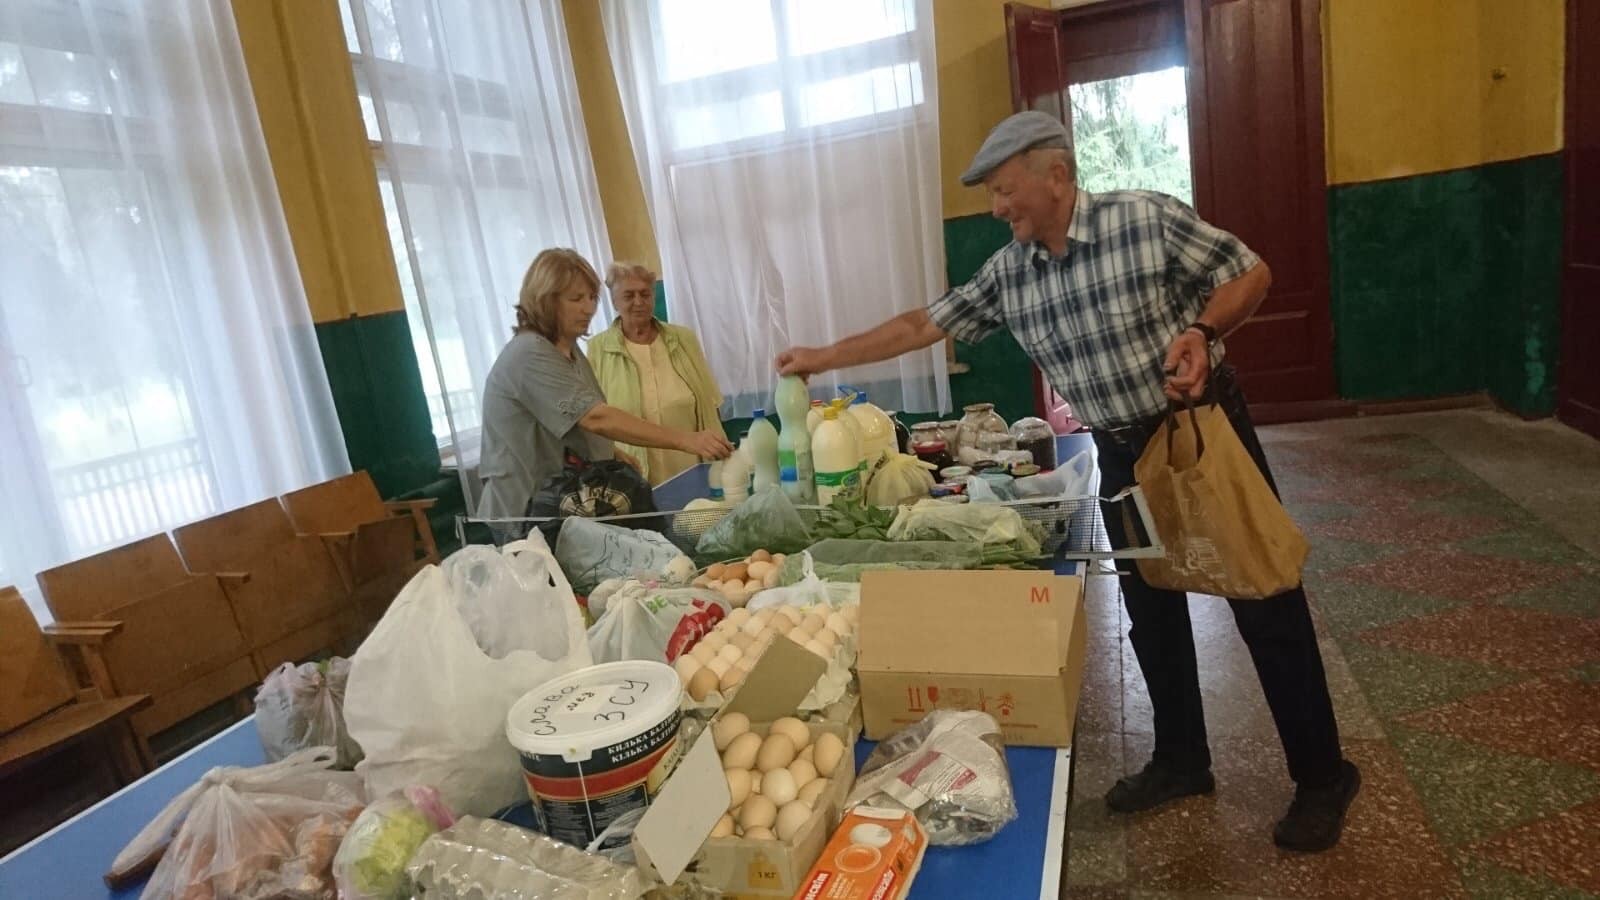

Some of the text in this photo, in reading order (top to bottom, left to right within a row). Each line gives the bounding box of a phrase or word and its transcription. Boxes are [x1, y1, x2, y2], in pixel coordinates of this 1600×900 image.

[1031, 586, 1050, 603] M
[608, 733, 649, 755] КИЛЬКА
[611, 743, 649, 764] КІЛЬКА
